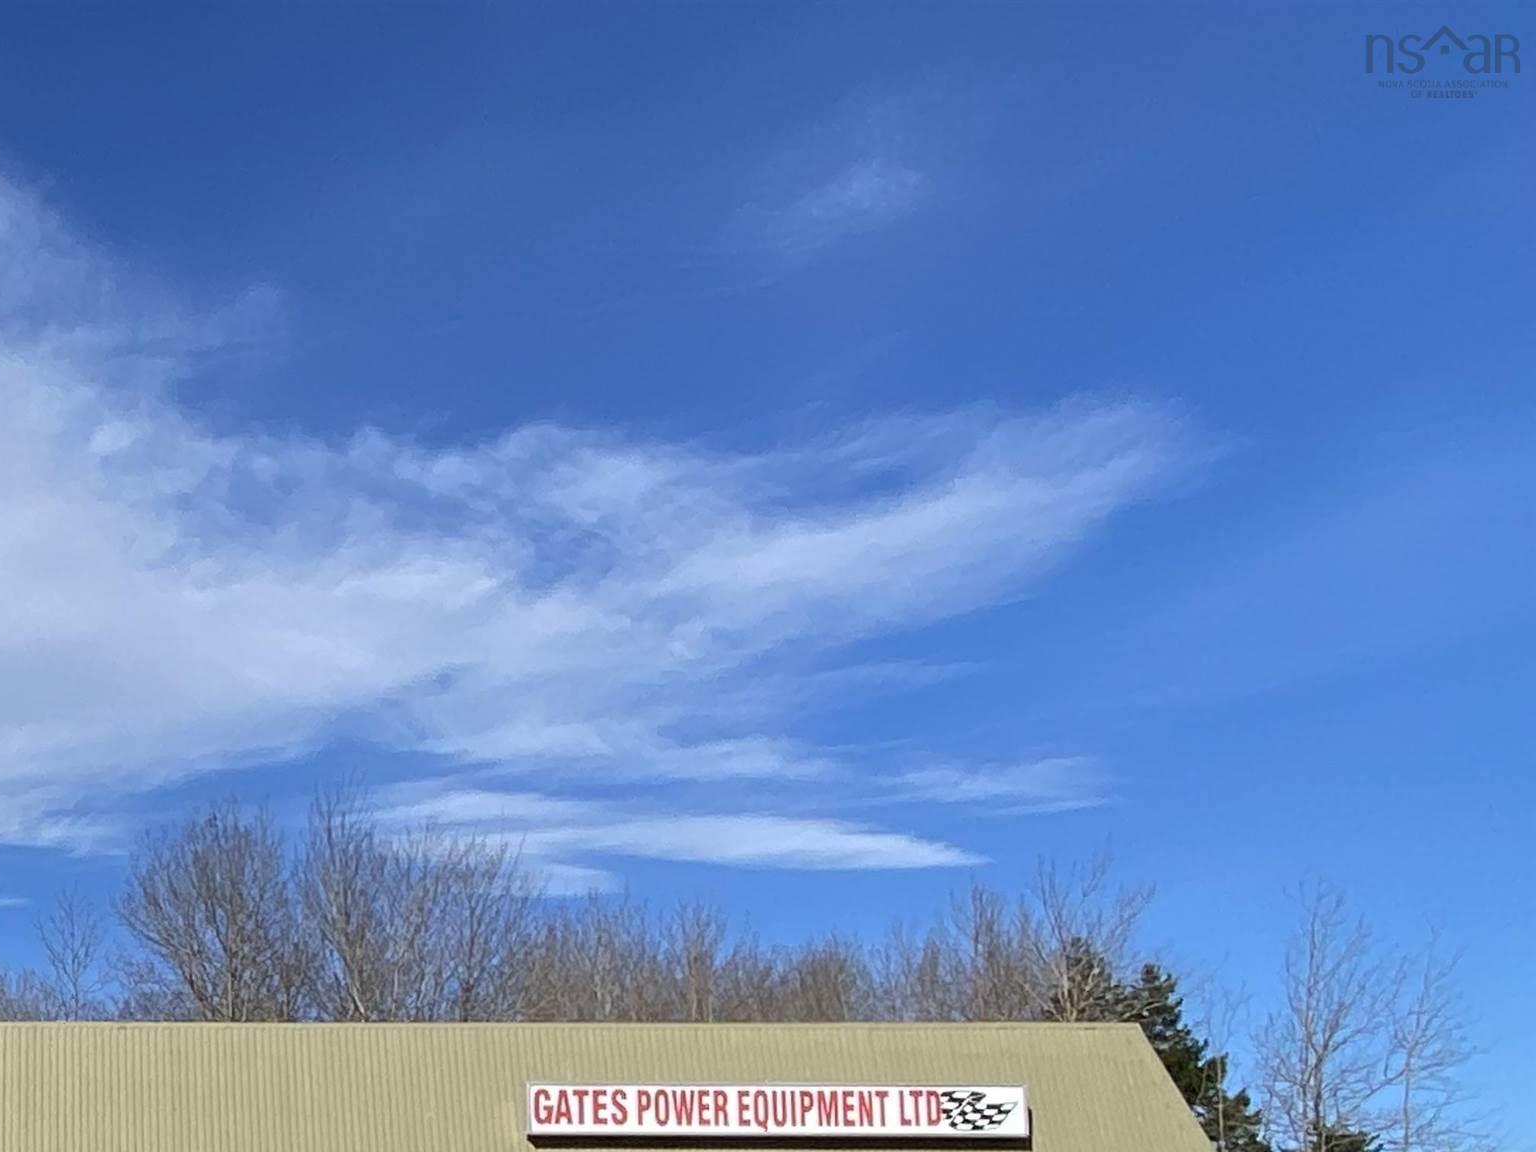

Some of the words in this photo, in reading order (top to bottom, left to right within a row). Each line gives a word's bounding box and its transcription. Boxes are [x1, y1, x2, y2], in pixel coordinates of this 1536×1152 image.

[533, 1088, 629, 1126] GATES
[637, 1089, 730, 1127] POWER
[737, 1089, 890, 1132] EQUIPMENT
[899, 1090, 942, 1127] LTD
